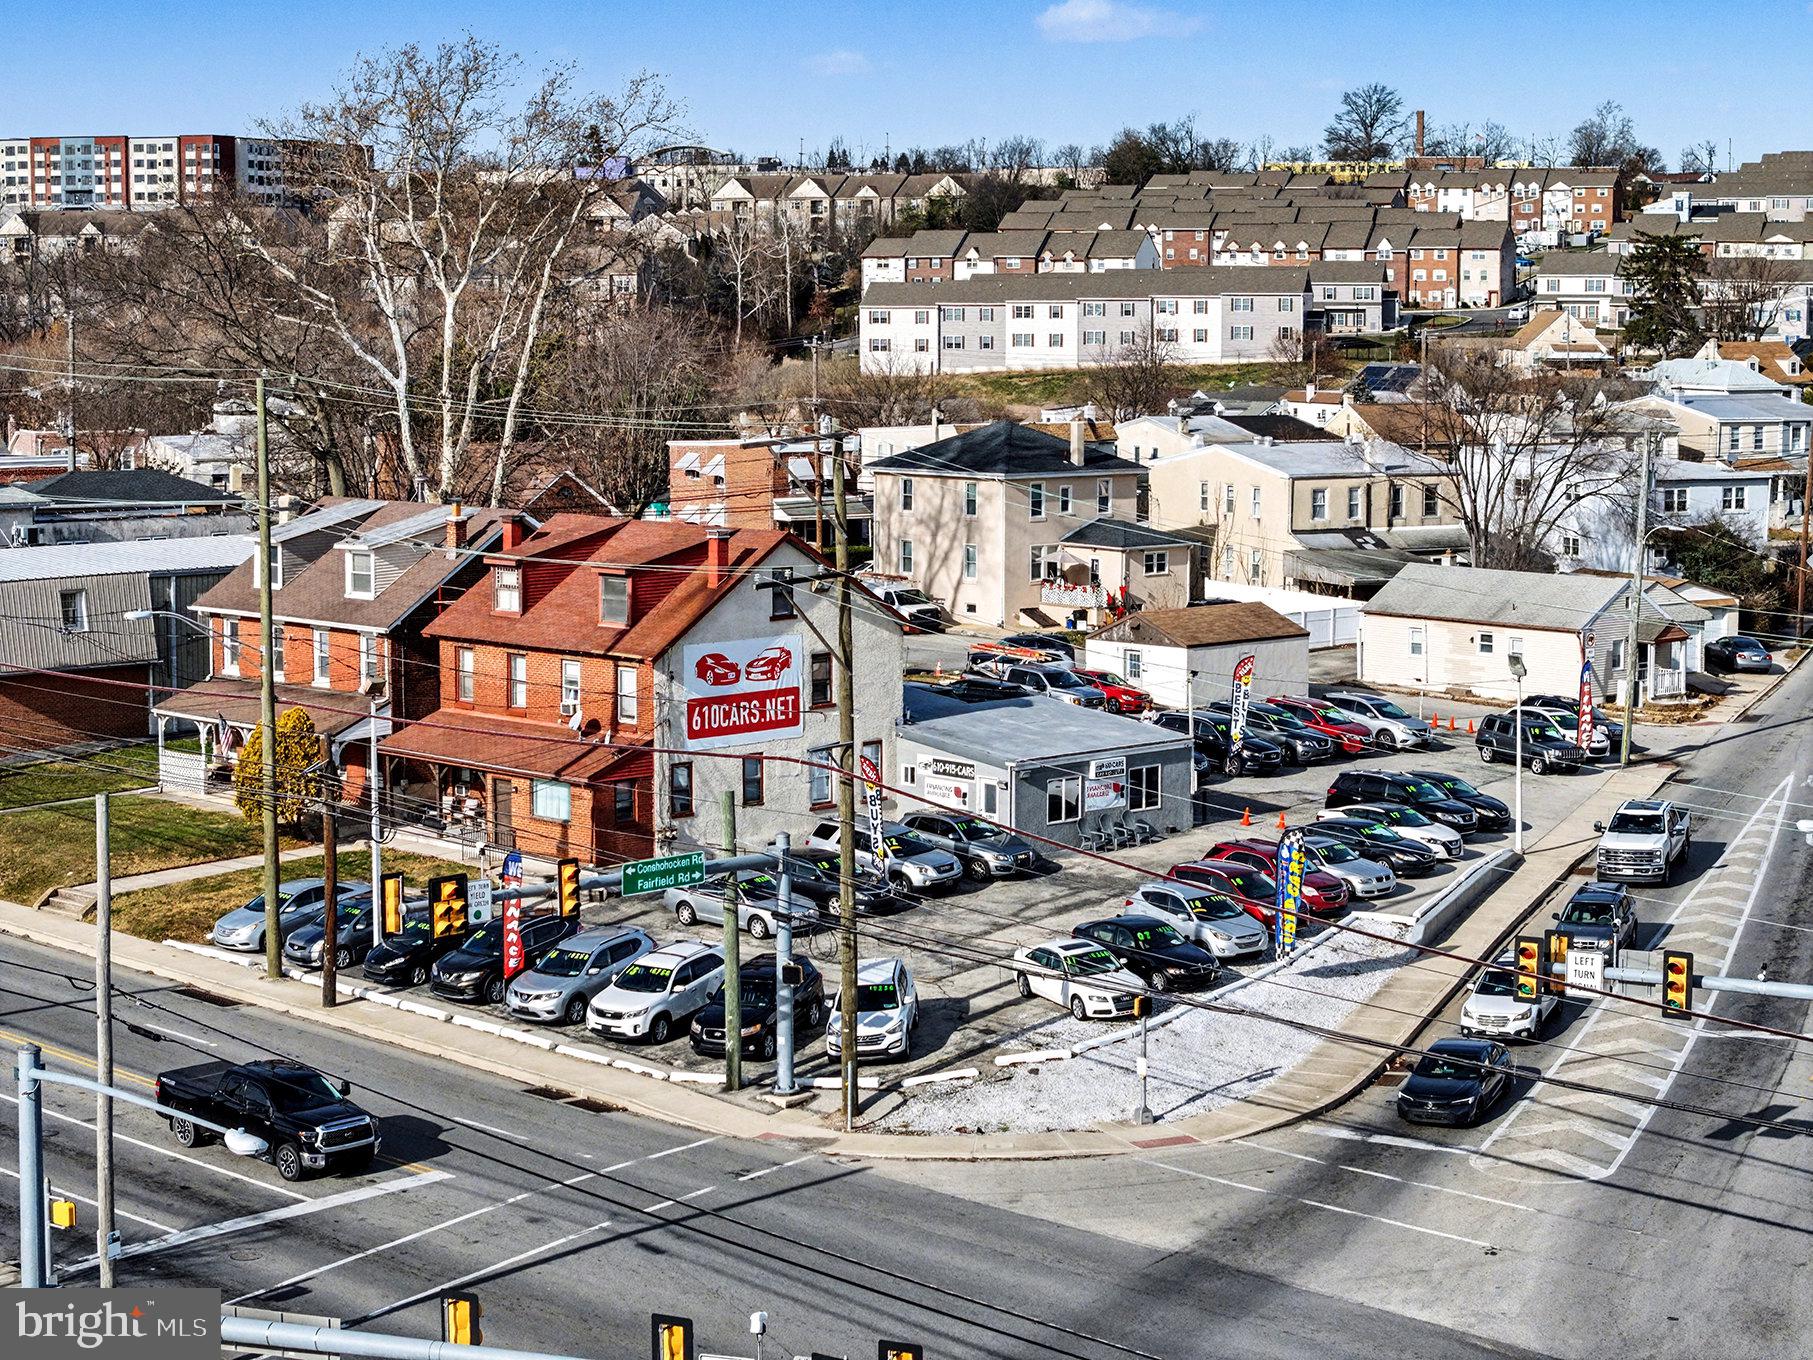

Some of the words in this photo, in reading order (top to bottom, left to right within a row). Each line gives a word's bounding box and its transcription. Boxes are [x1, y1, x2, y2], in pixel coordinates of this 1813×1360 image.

[692, 695, 795, 731] 610CARS.NET
[1232, 683, 1242, 729] BEST
[508, 861, 522, 877] WE
[637, 859, 690, 875] Conshohocken
[692, 854, 704, 865] Rd
[637, 875, 675, 890] Fairfield
[678, 871, 690, 883] Rd
[470, 891, 486, 900] YIELD
[1574, 956, 1595, 966] LEFT
[1574, 969, 1595, 979] TURN
